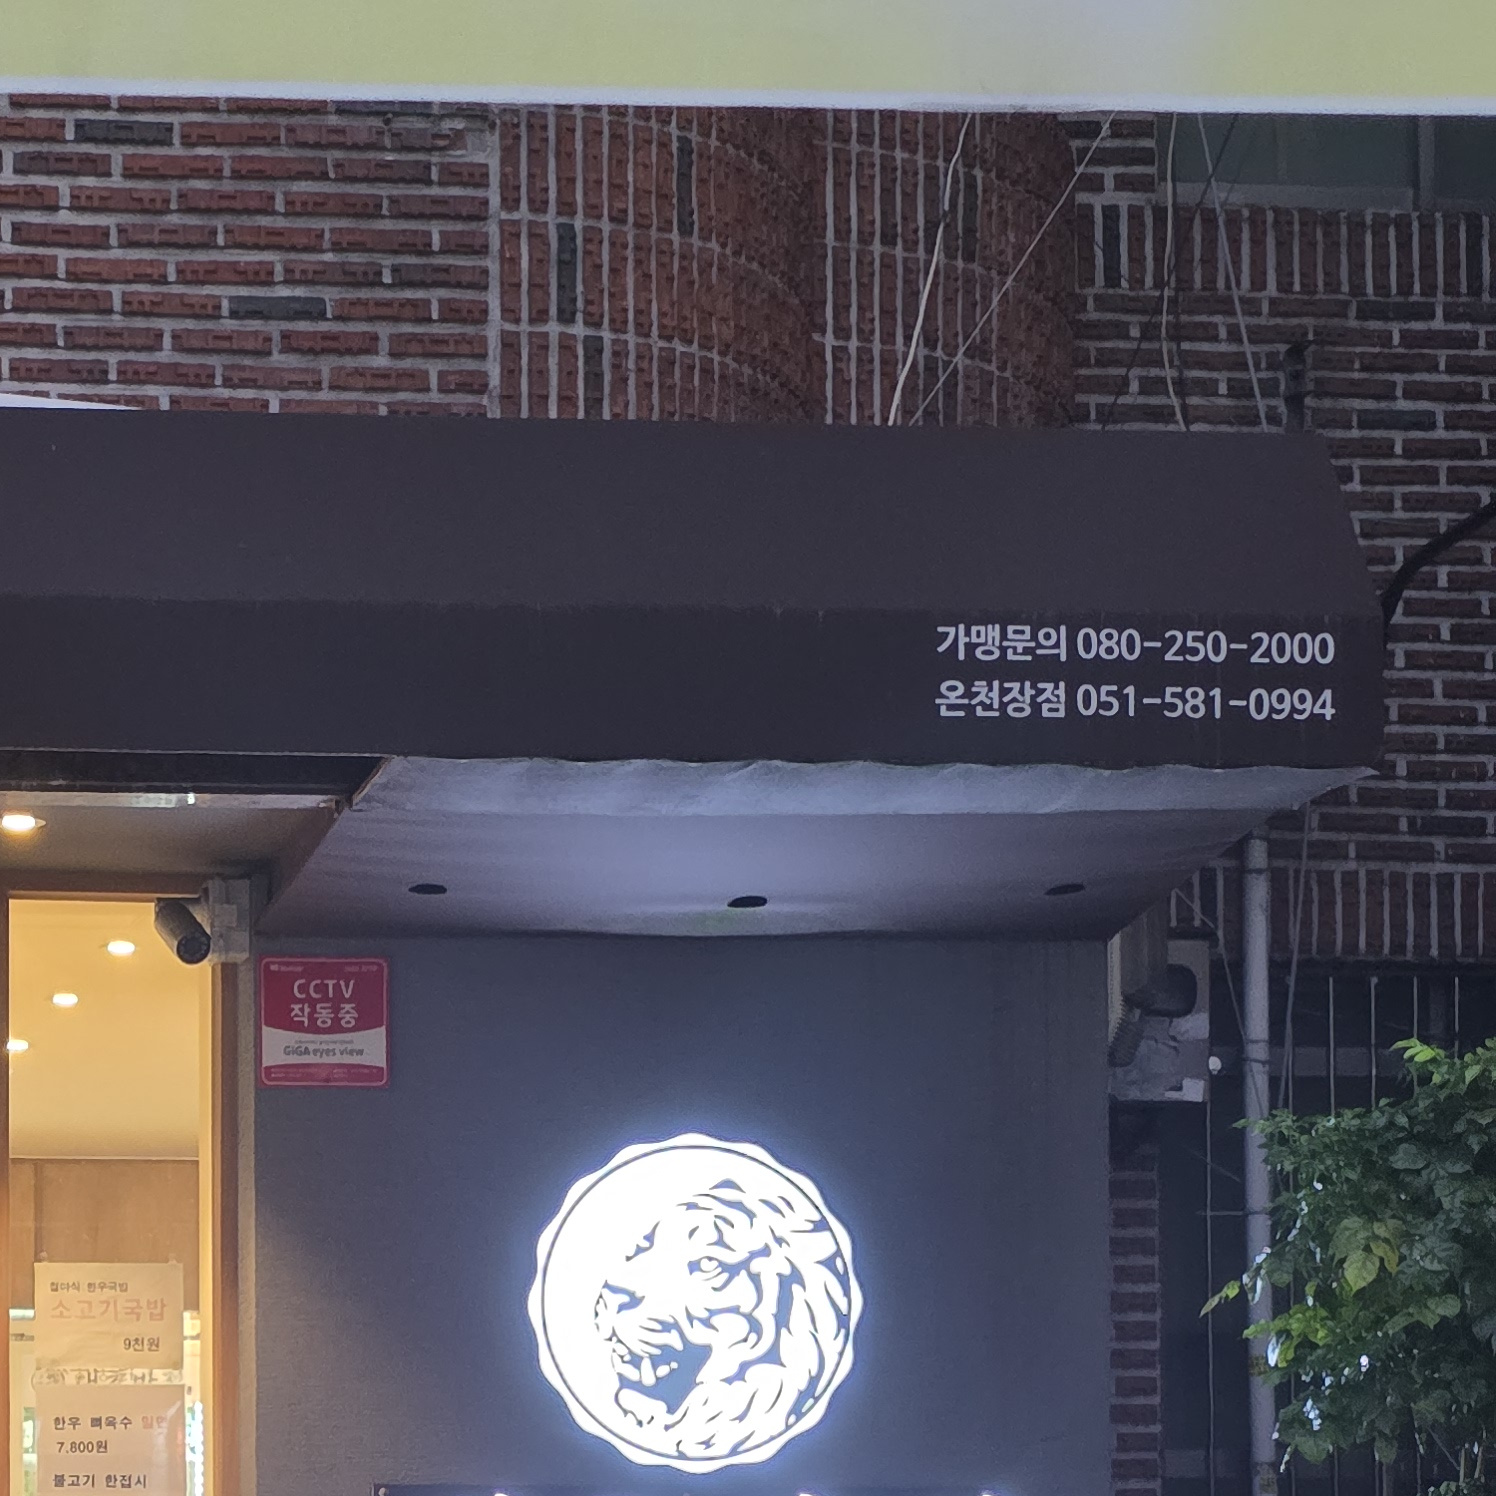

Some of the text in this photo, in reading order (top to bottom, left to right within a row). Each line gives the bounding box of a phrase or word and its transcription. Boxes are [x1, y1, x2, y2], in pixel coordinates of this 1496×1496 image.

[936, 624, 1336, 664] 가맹문의 080-250-2000
[935, 679, 1336, 721] 온천장점 051-581-0994
[293, 979, 355, 998] CCTV
[290, 1003, 359, 1028] 작동중
[312, 1047, 336, 1058] eyes
[339, 1046, 364, 1057] view
[51, 1297, 167, 1322] 소고기국밥
[123, 1336, 161, 1352] 9천원
[53, 1416, 82, 1430] 한우
[52, 1474, 147, 1489] 불고기 한접시
